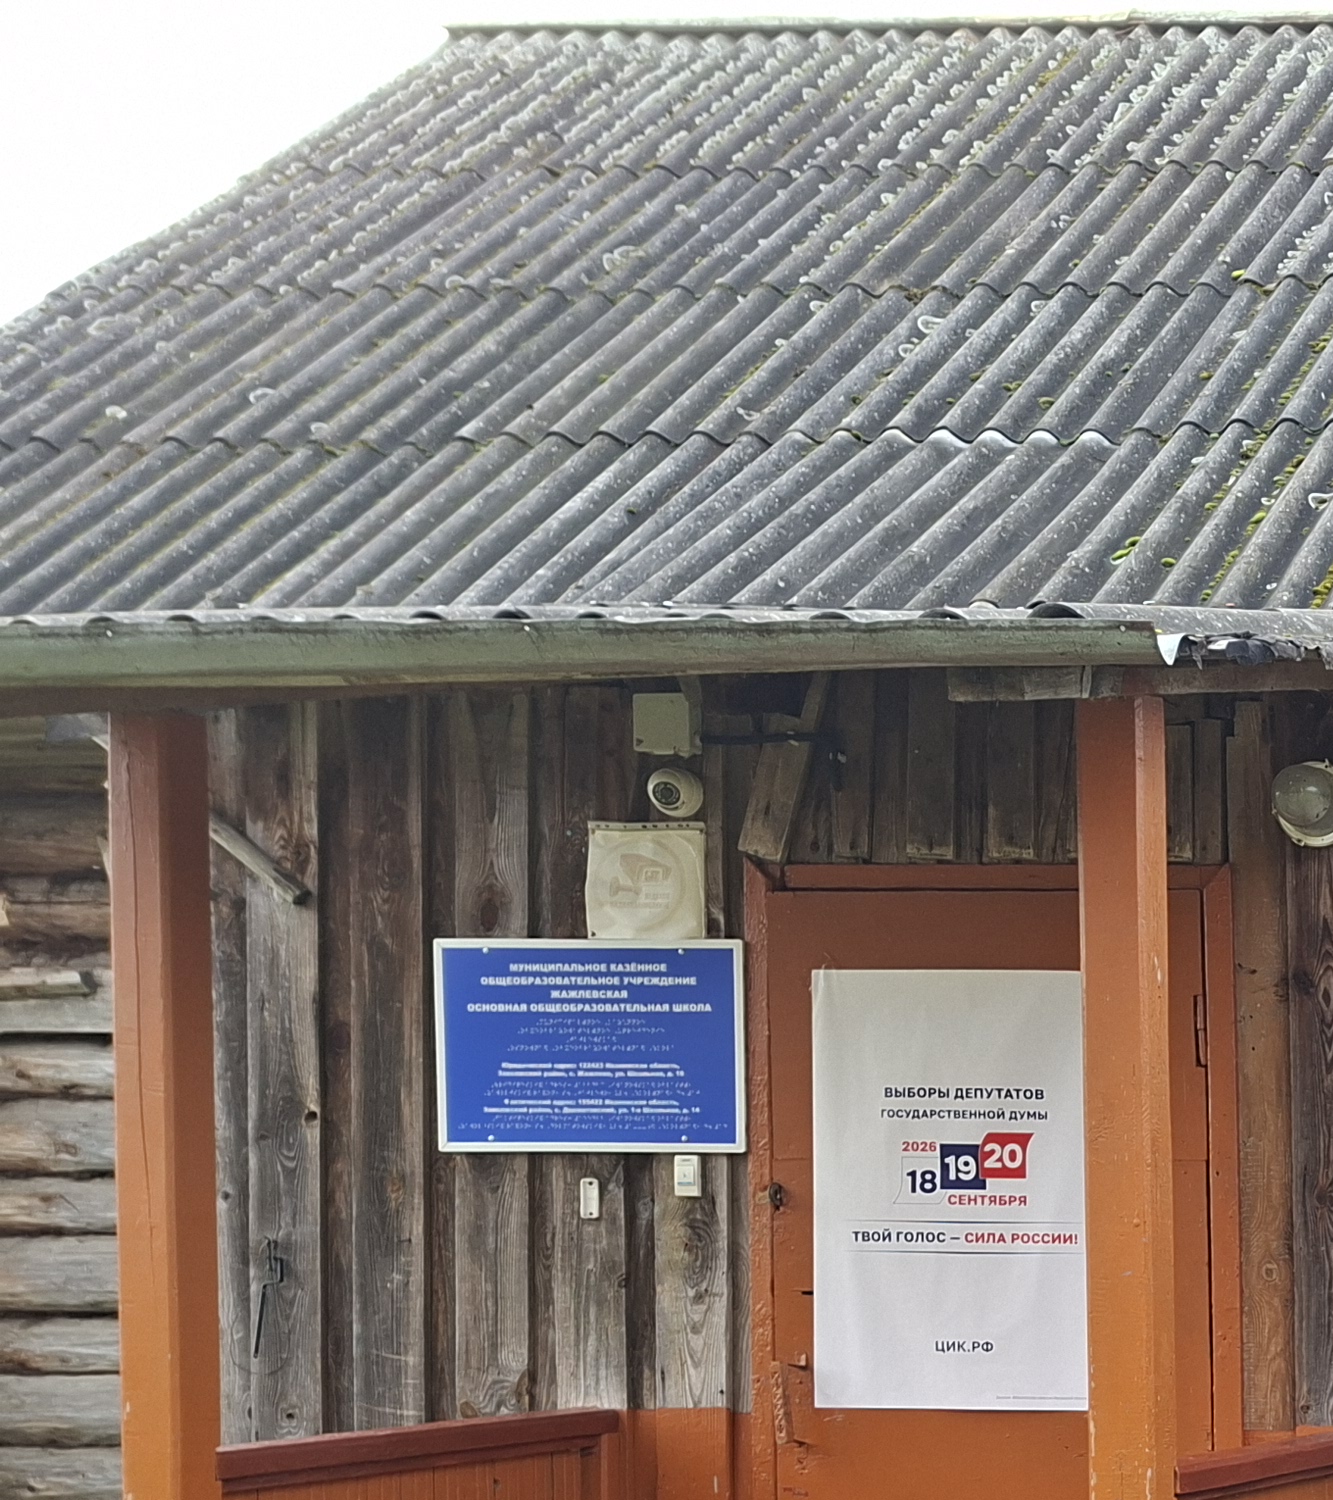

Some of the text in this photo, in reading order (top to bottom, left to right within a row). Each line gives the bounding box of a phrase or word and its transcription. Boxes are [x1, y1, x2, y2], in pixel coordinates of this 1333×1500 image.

[509, 962, 667, 973] МУНИЦИПАЛЬНОЕ КАЗЁННОЕ
[480, 976, 697, 986] ОБЩЕОБРАЗОВАТЕЛЬНОЕ УЧРЕЖДЕНИЕ
[550, 989, 628, 999] ЖАЖЛЕВСКАЯ
[467, 1003, 712, 1013] ОСНОВНАЯ ОБЩЕОБРАЗОВАТЕЛЬНАЯ ШКОЛА
[884, 1087, 1045, 1100] ВЫБОРЫ ДЕПУТАТОВ
[881, 1108, 1048, 1121] ГОСУДАРСТВЕННОЙ ДУМЫ
[902, 1141, 937, 1152] 2026
[906, 1142, 1024, 1194] 18 19 20
[947, 1194, 1027, 1206] СЕНТЯБРЯ
[852, 1228, 892, 1243] ТВОЙ
[896, 1231, 947, 1243] ГОЛОС
[964, 1232, 1007, 1244] СИЛА
[1011, 1233, 1079, 1245] РОССИИ!
[935, 1340, 994, 1353] ЦИК.РФ
